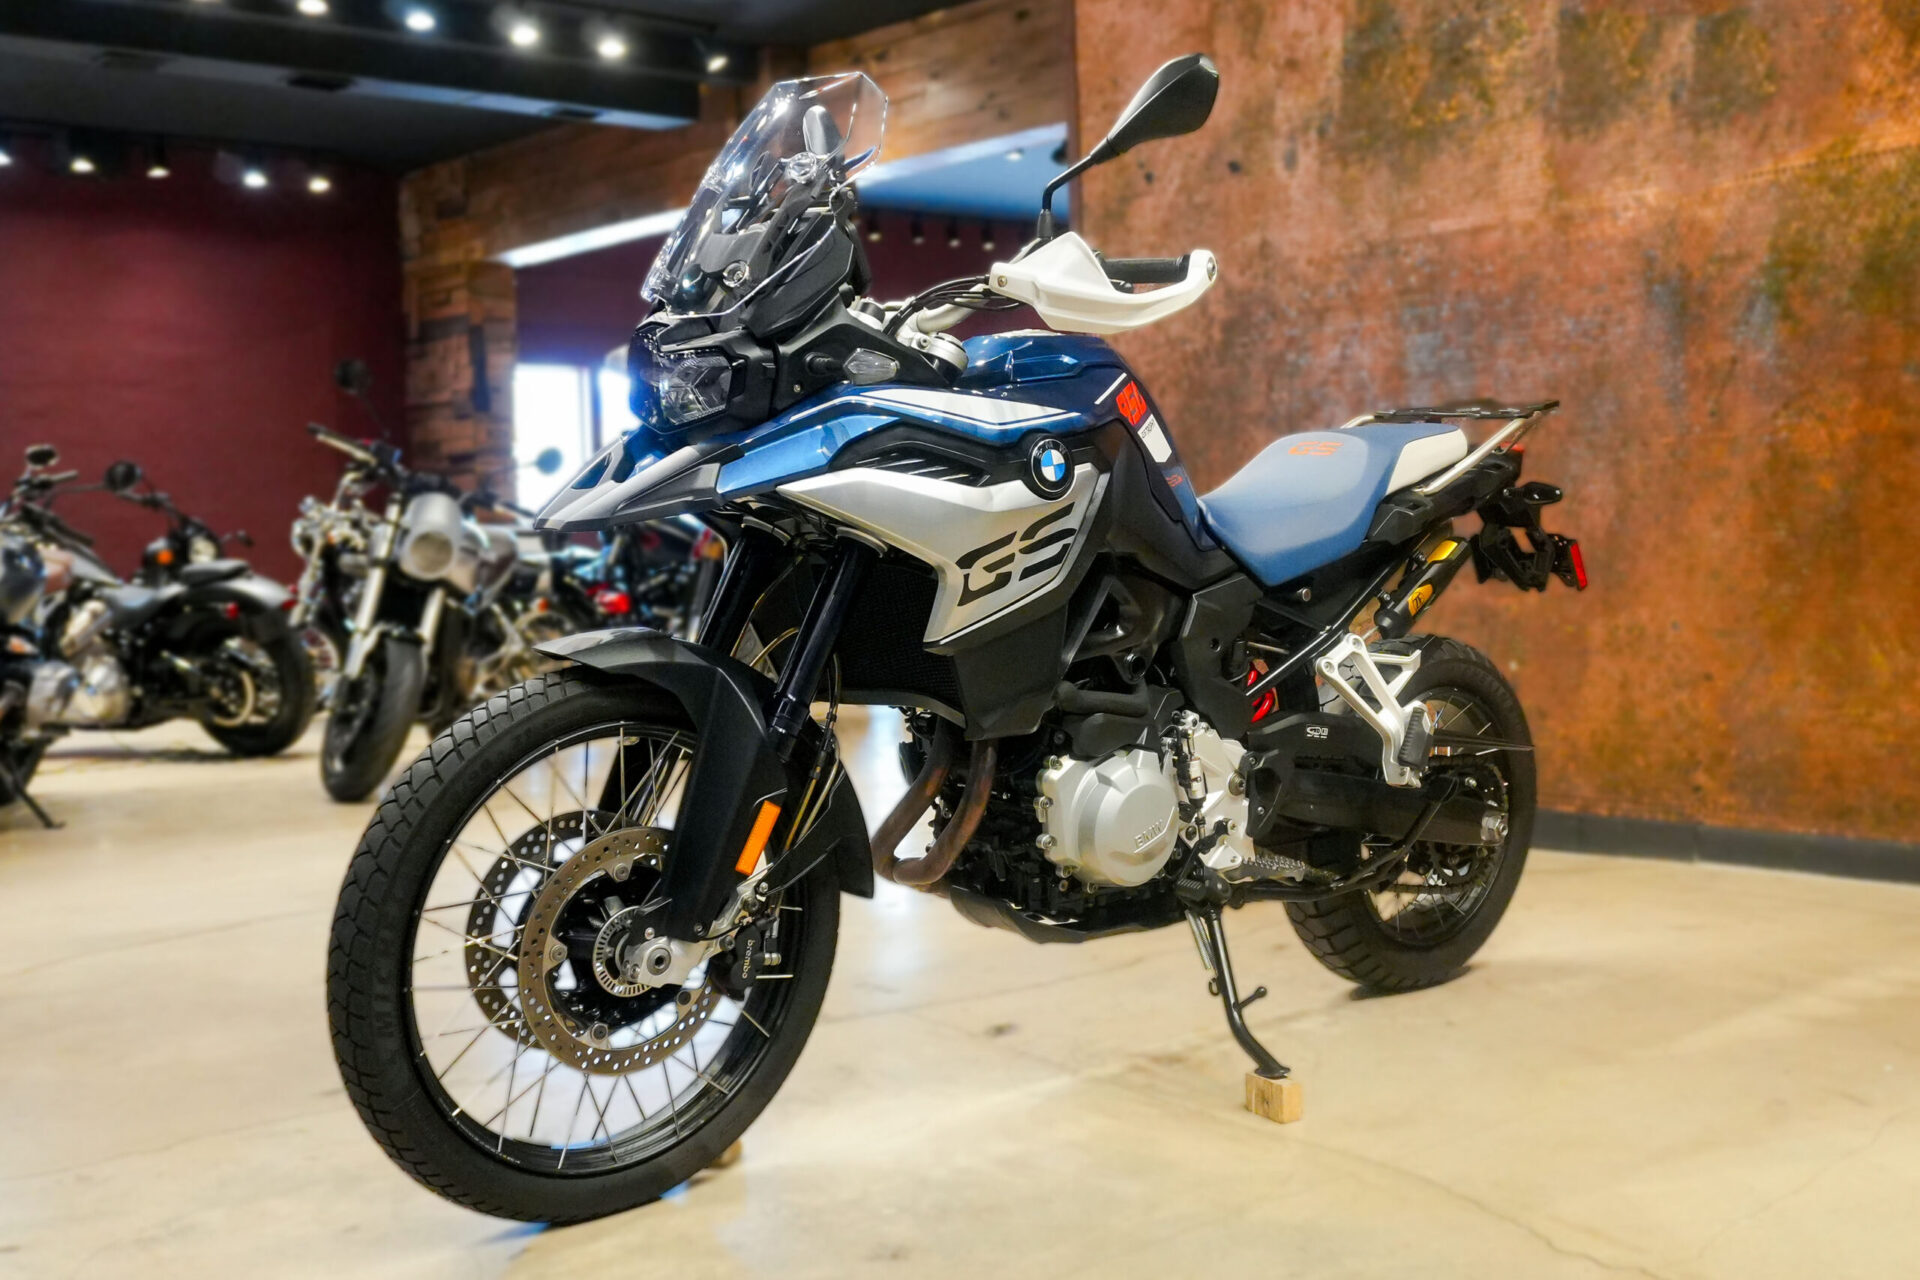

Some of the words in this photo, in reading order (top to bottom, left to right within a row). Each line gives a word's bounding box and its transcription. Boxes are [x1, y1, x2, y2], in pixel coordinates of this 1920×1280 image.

[1288, 440, 1345, 456] GS
[955, 501, 1078, 607] GS
[742, 939, 756, 979] brembo
